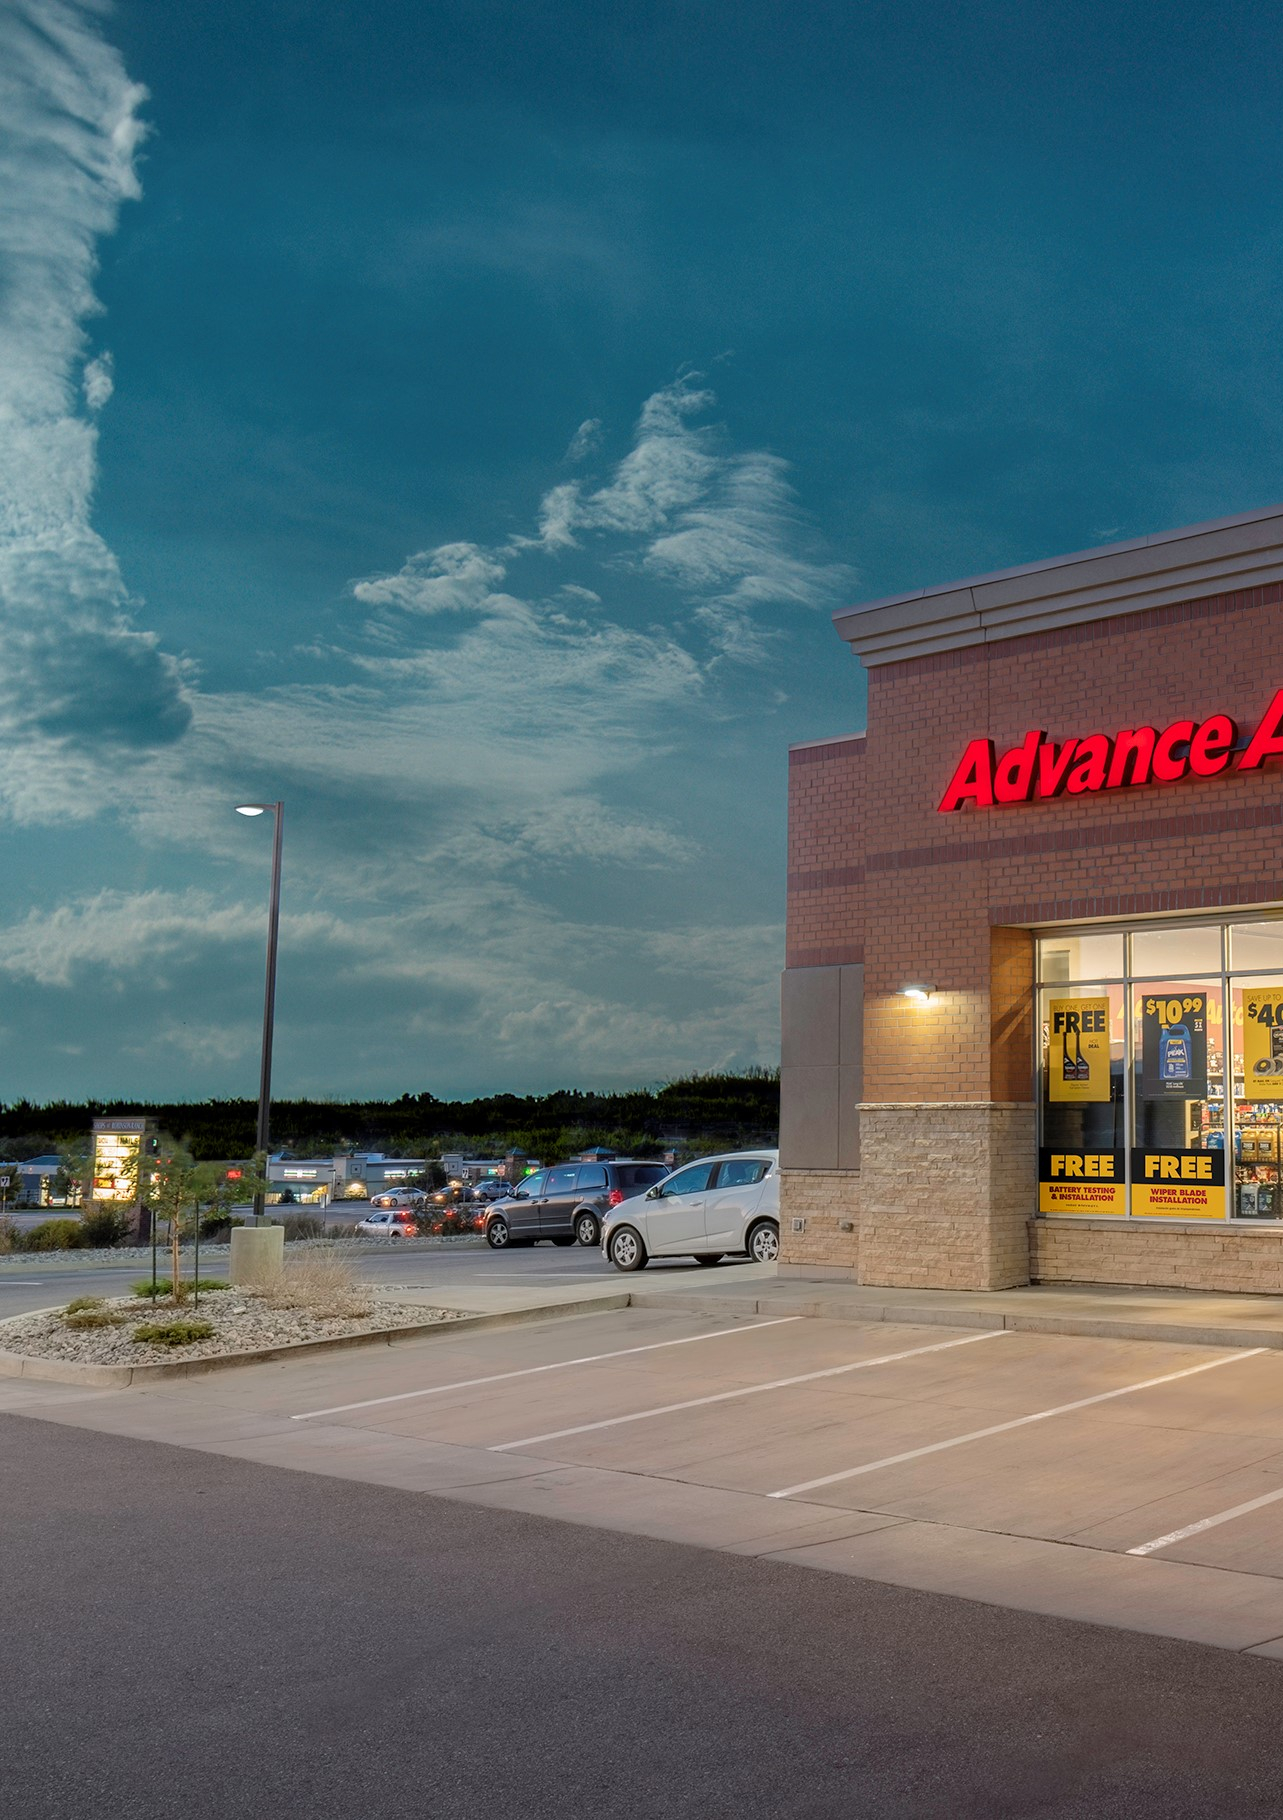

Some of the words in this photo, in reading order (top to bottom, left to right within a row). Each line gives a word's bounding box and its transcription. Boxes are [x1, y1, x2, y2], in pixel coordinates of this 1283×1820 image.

[937, 713, 1238, 813] Advance
[1247, 994, 1262, 1002] SAVE
[1273, 993, 1281, 1001] TO
[1054, 1010, 1105, 1033] FREE
[1167, 1048, 1185, 1057] PEAK
[1051, 1155, 1115, 1177] FREE
[1145, 1155, 1212, 1179] FREE
[1150, 1196, 1208, 1204] INSTALLATION
